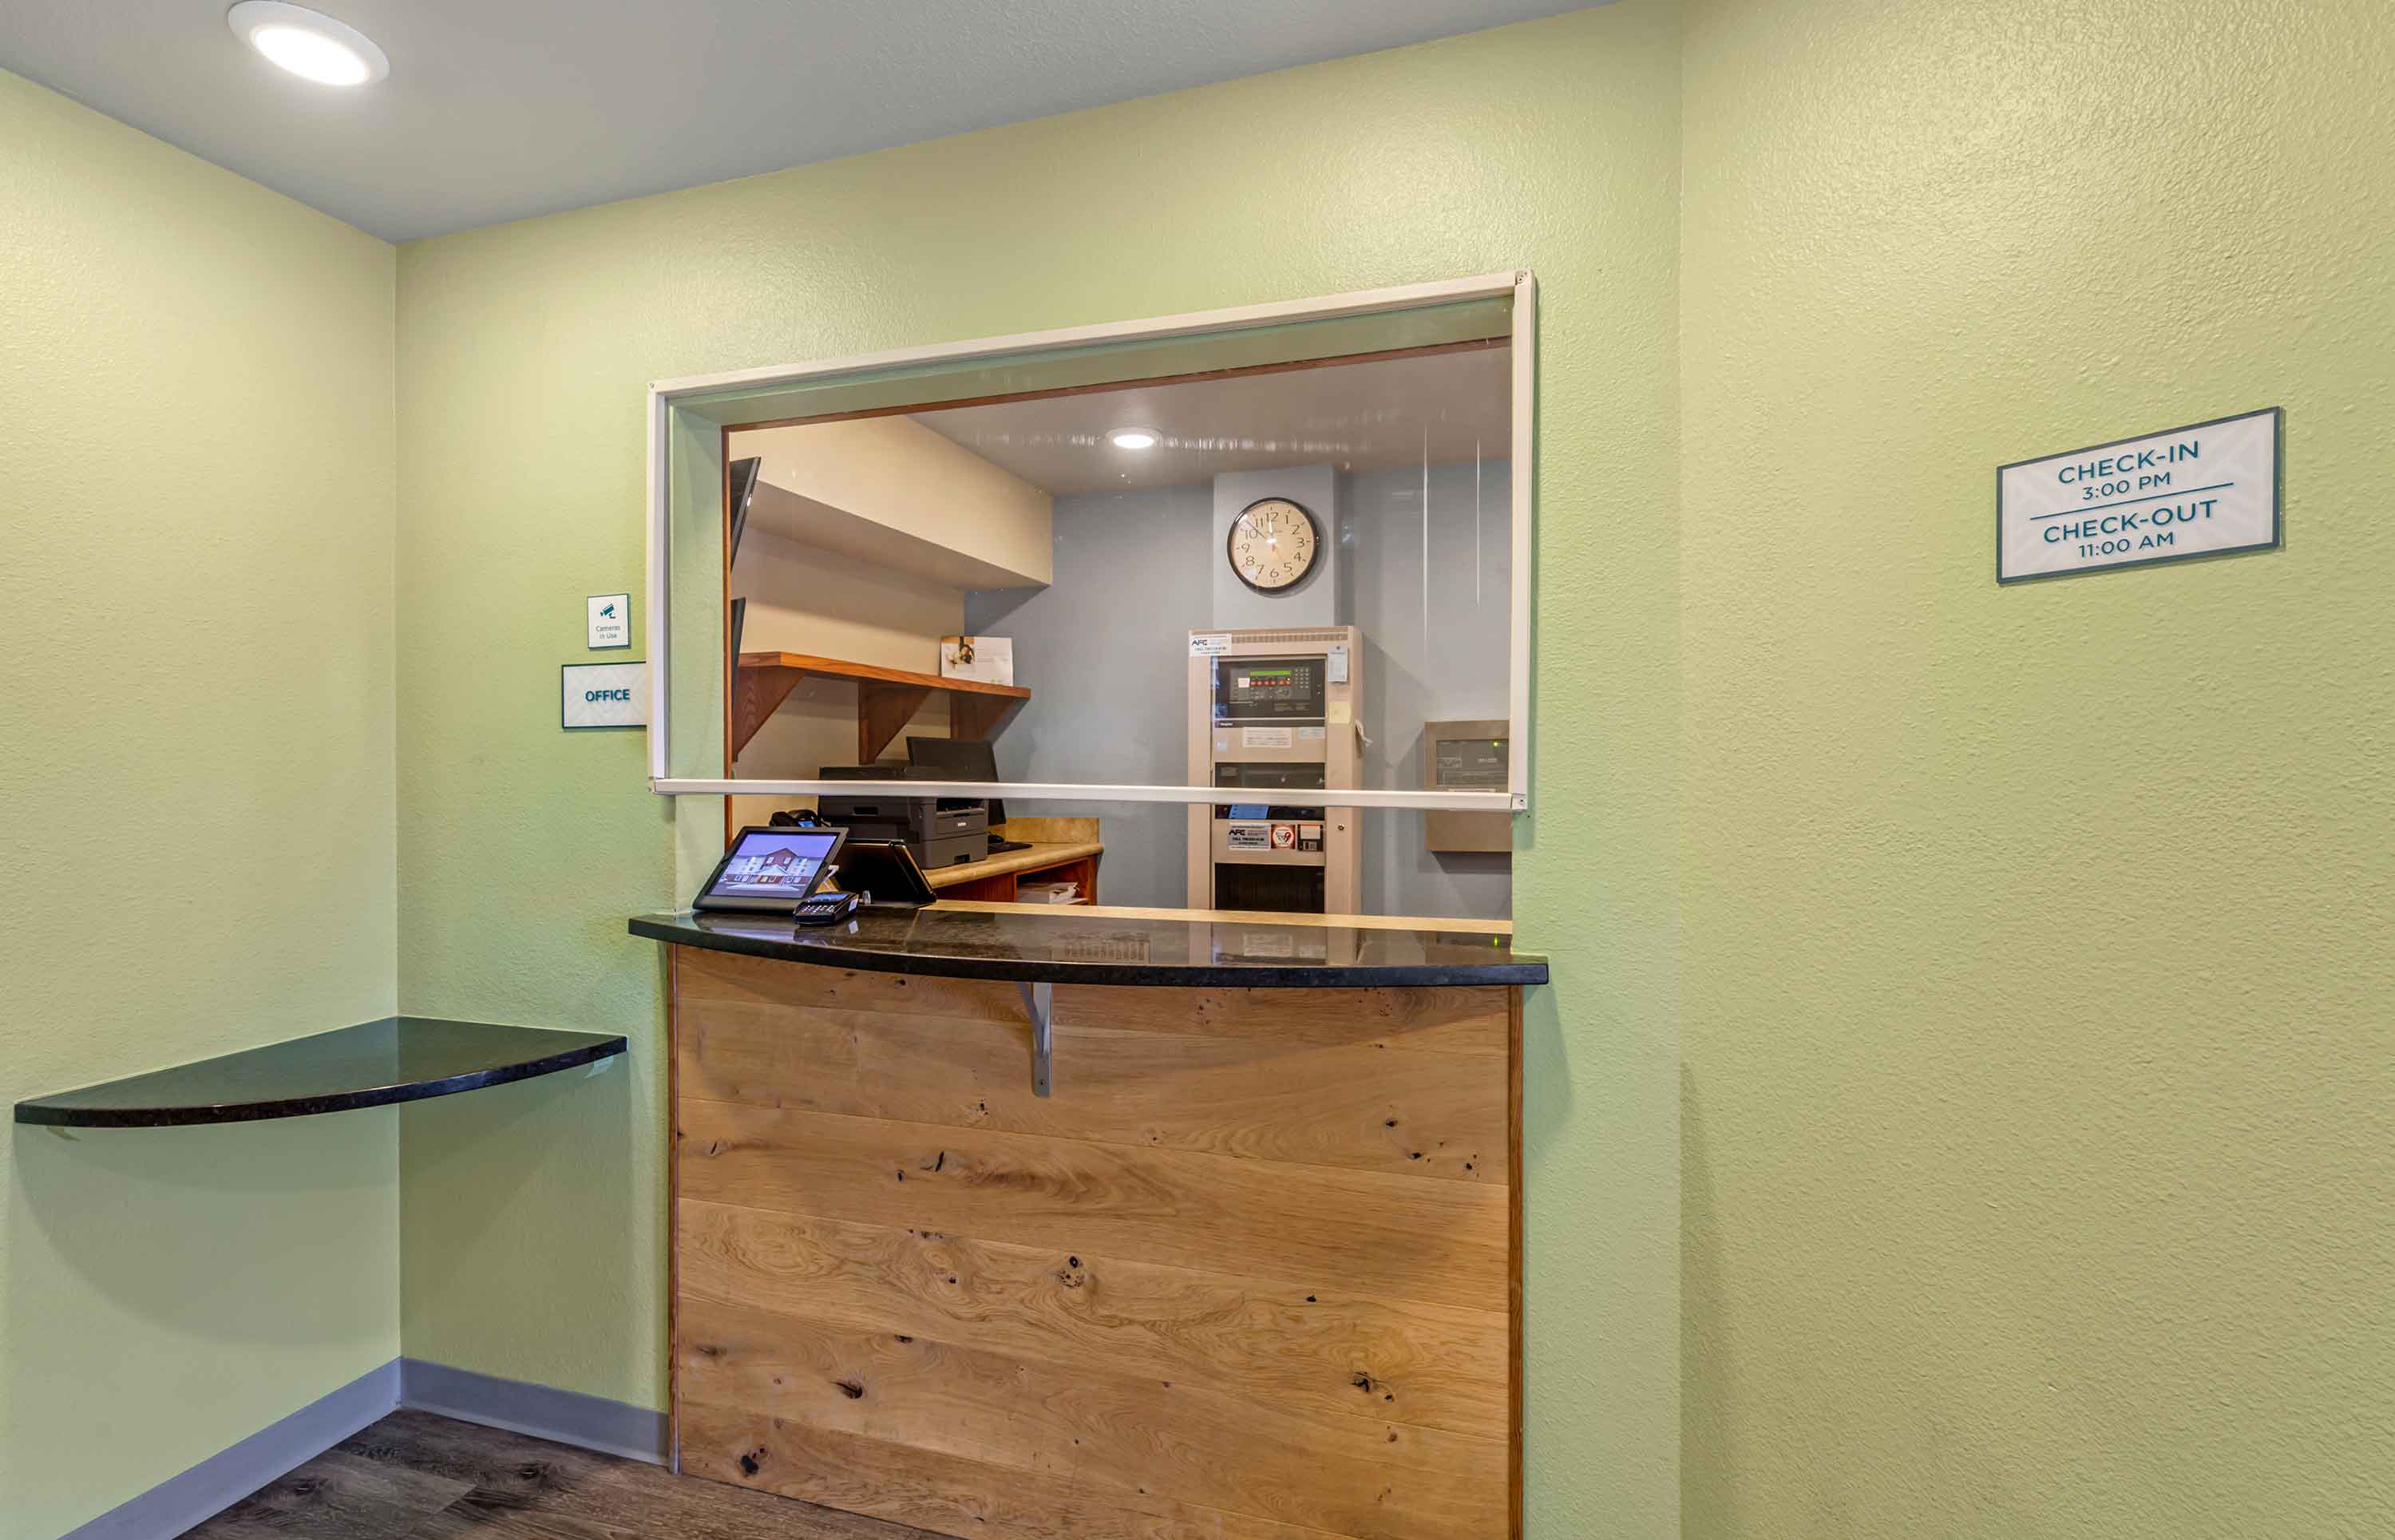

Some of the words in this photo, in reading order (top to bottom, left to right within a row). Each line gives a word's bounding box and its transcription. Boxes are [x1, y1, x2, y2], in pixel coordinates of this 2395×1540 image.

[2058, 440, 2199, 484] CHECK-IN
[2082, 480, 2130, 500] 3:00
[2139, 472, 2171, 490] PM
[1256, 517, 1264, 528] 11
[1266, 512, 1279, 522] 12
[1285, 514, 1289, 525] 1
[2043, 500, 2218, 543] CHECK-OUT
[1245, 529, 1258, 540] 10
[1292, 525, 1300, 536] 2
[1241, 543, 1250, 553] 9
[1296, 537, 1305, 548] 3
[2079, 537, 2130, 557] 11:00
[2139, 532, 2174, 550] AM
[1245, 556, 1255, 566] 8
[1293, 552, 1302, 562] 4
[1257, 564, 1265, 576] 7
[1283, 562, 1293, 572] 5
[1269, 568, 1279, 579] 6
[585, 689, 631, 702] OFFICE
